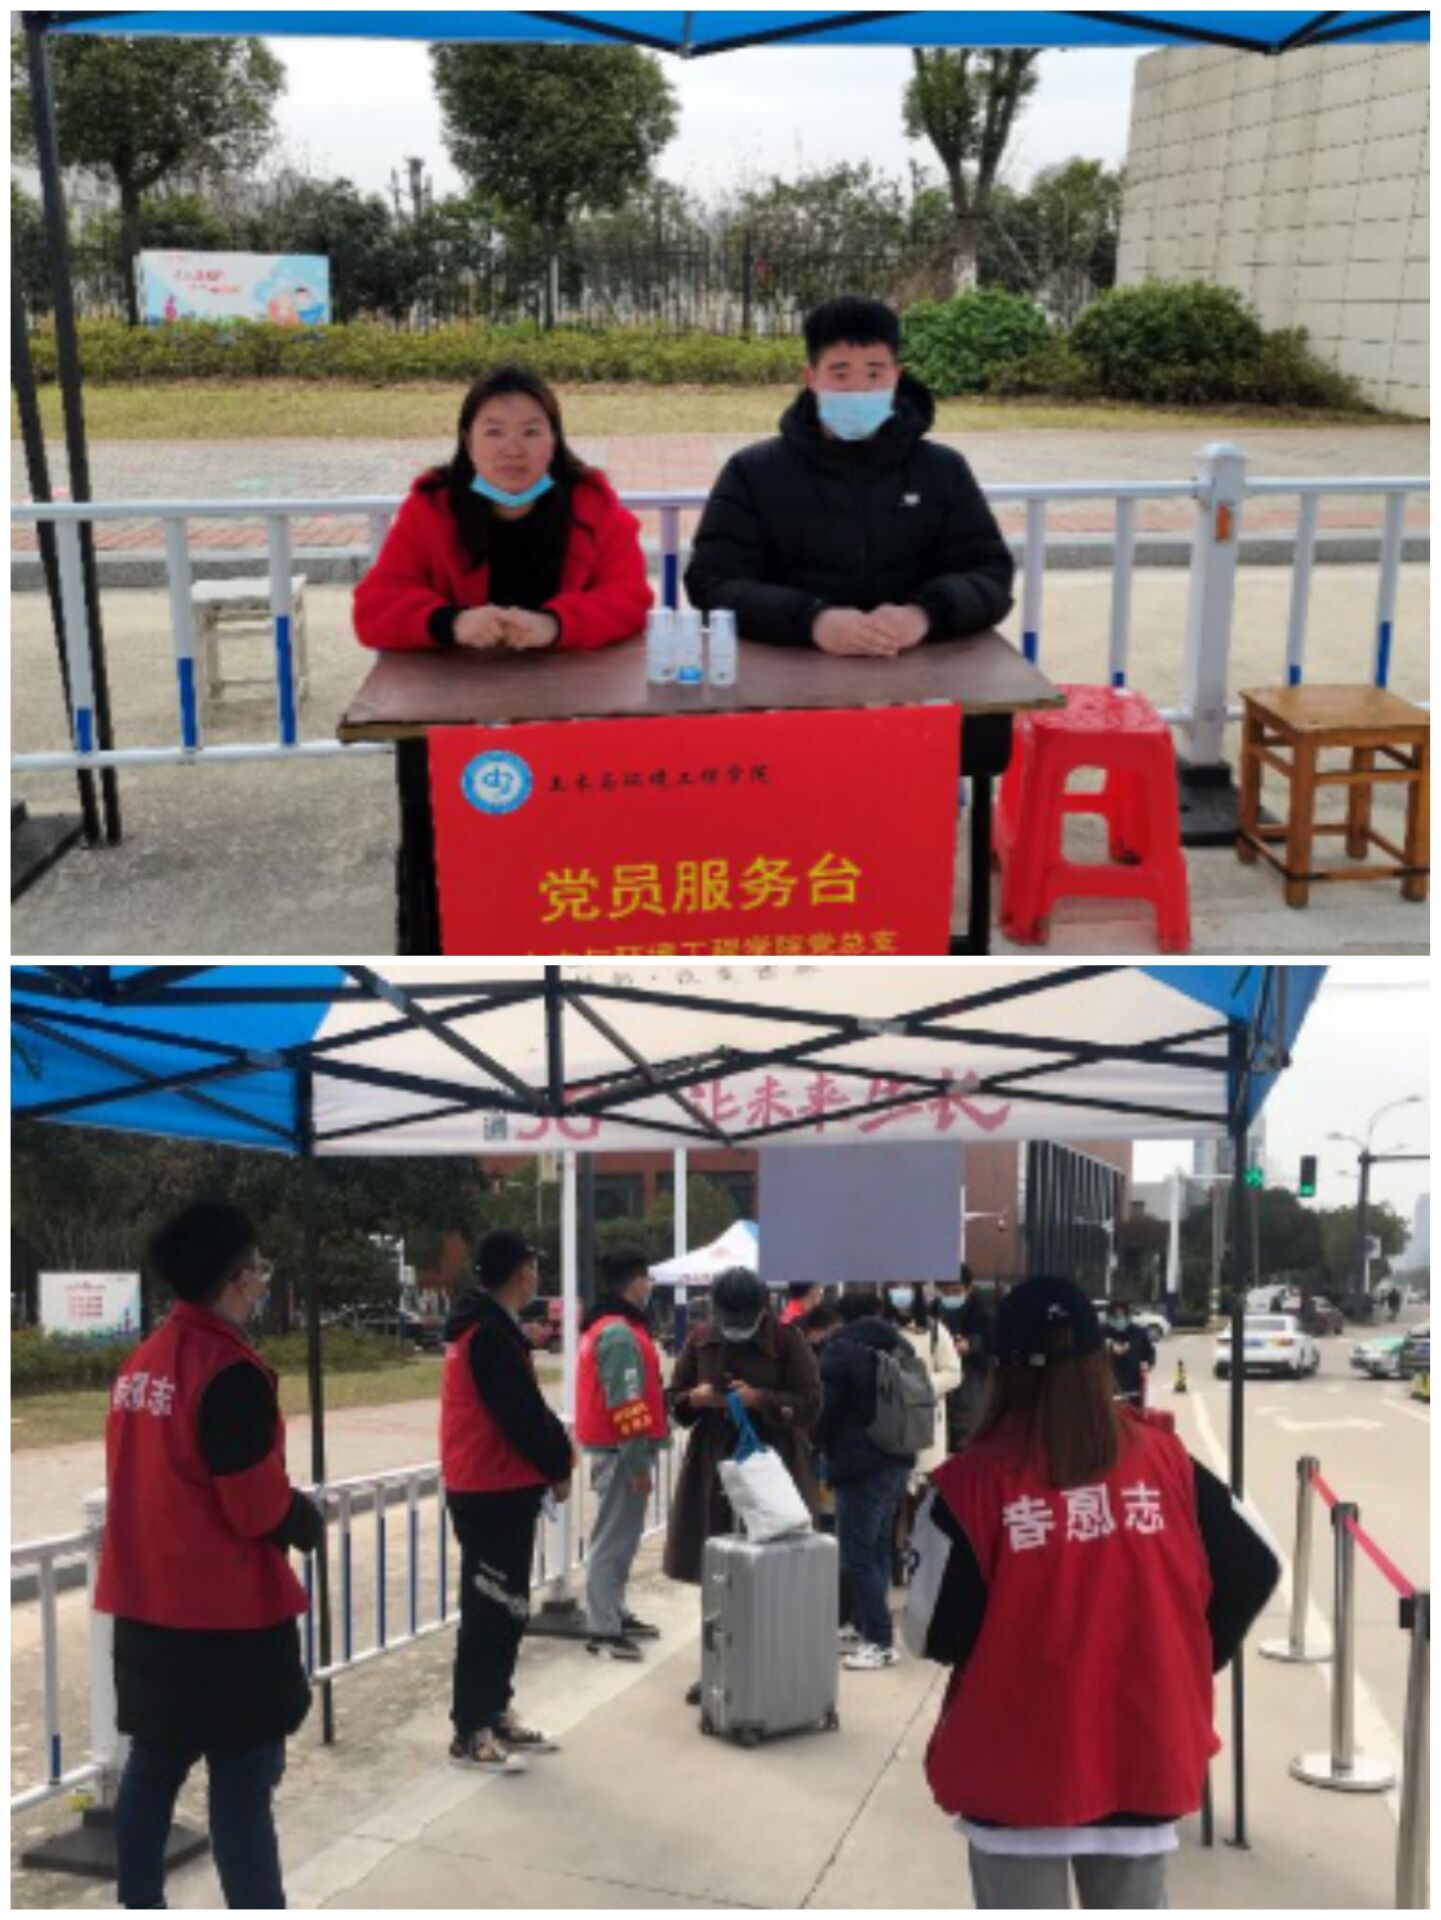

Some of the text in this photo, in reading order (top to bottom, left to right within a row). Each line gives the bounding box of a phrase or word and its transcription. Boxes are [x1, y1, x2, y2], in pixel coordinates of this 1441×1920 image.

[539, 851, 862, 923] 党员服务台
